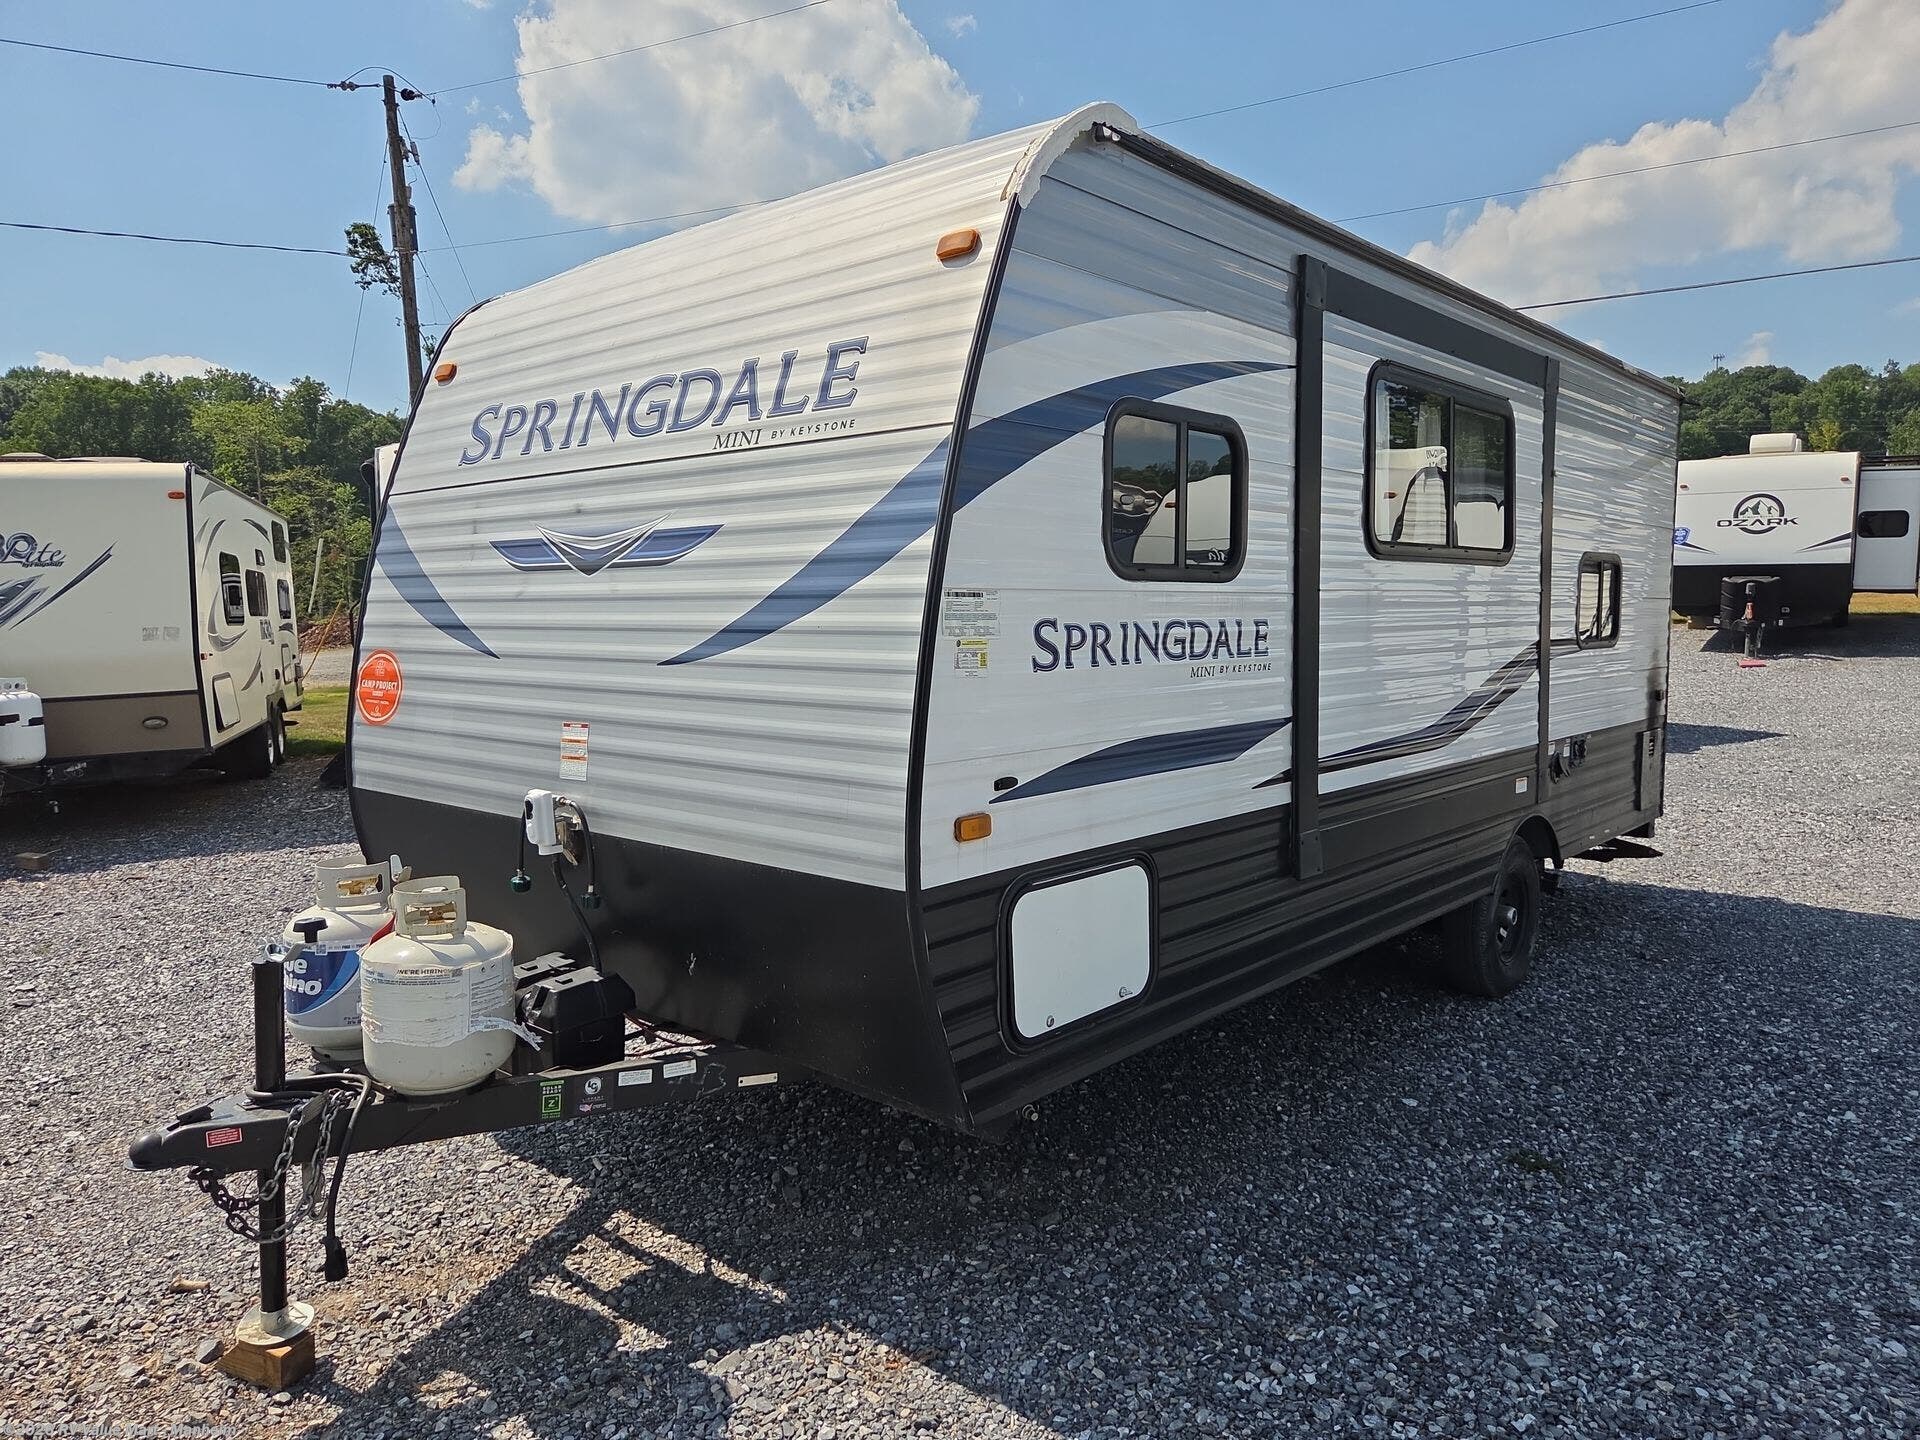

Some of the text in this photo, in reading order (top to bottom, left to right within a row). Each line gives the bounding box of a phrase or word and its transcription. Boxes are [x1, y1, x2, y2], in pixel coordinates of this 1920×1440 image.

[458, 335, 869, 466] SPRINGDALE
[712, 419, 856, 450] MINI BY KEYSTONE
[1716, 517, 1798, 527] OZARK
[1031, 618, 1269, 673] SPRINGDALE
[1190, 662, 1272, 678] MINI BY KEYSTONE
[361, 679, 397, 690] CAMP PROJECT
